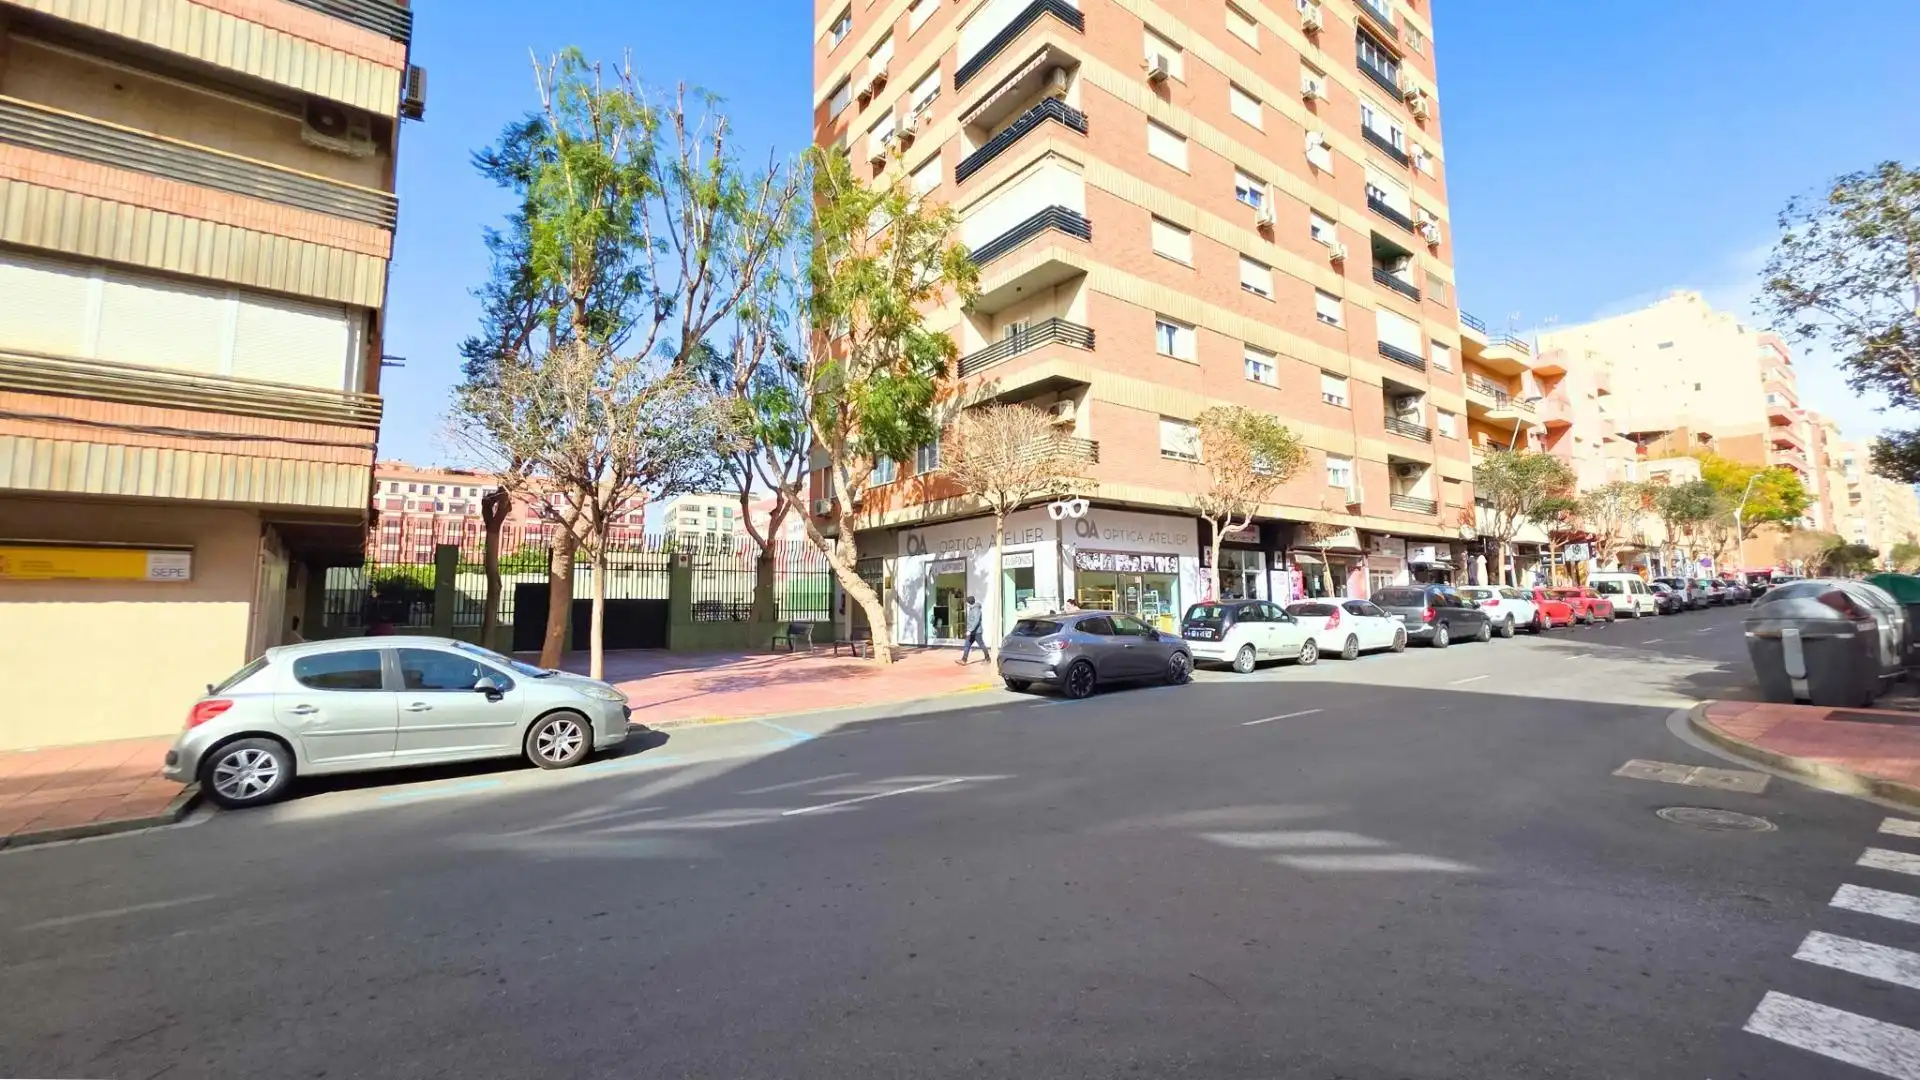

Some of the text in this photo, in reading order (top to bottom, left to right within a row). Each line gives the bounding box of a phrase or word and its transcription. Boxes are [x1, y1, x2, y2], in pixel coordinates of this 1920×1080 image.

[907, 532, 927, 555] OA
[989, 527, 1043, 547] AELIER
[1075, 518, 1188, 545] OA OPTICA ATELIER
[151, 567, 187, 578] SEPE
